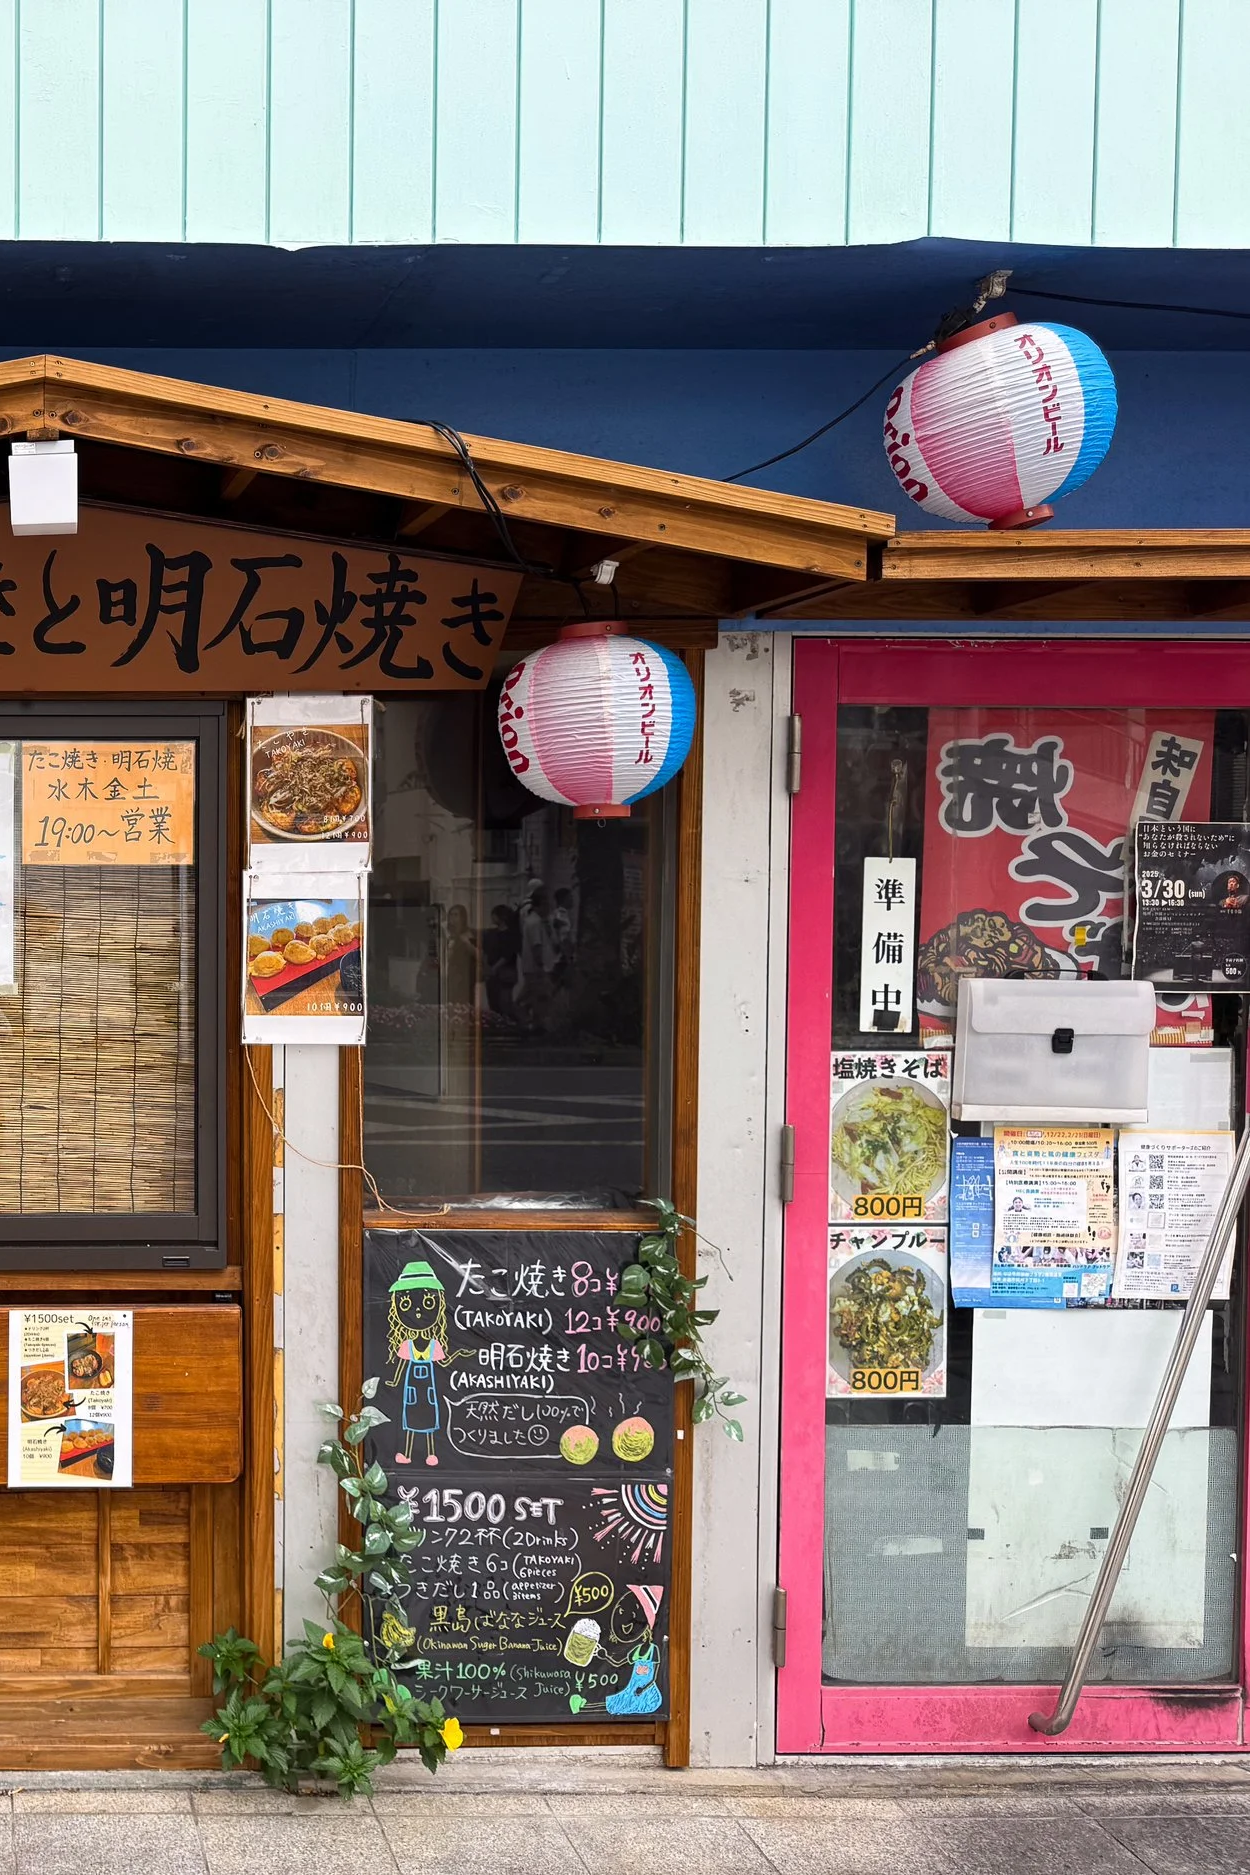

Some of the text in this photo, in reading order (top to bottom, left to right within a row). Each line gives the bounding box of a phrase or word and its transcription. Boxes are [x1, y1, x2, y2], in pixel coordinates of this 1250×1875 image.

[1013, 333, 1065, 456] オリオンビール
[884, 386, 929, 503] Orion
[500, 662, 530, 774] Orion
[629, 652, 656, 764] オリオンビール
[265, 739, 306, 758] TAKOYAKI
[47, 777, 160, 802] 水木金土
[1143, 825, 1196, 833] 日本という国に
[1141, 879, 1206, 899] 3/30 (sun)
[871, 878, 906, 1013] 準備中
[832, 1056, 943, 1080] 塩焼きそば
[853, 1196, 923, 1217] 800円
[830, 1230, 945, 1250] チャンプルー
[24, 1313, 74, 1323] ¥1500set
[454, 1304, 553, 1335] (TAKOYAKI)
[450, 1370, 554, 1393] (AKASHIYAKI)
[851, 1370, 919, 1391] 800円
[453, 1427, 527, 1446] つくりました
[397, 1486, 564, 1525] ¥1500 SET
[574, 1586, 609, 1606] ¥500
[417, 1635, 468, 1654] (Okinawan
[533, 1682, 571, 1697] Juice)
[575, 1671, 619, 1692] ¥500
